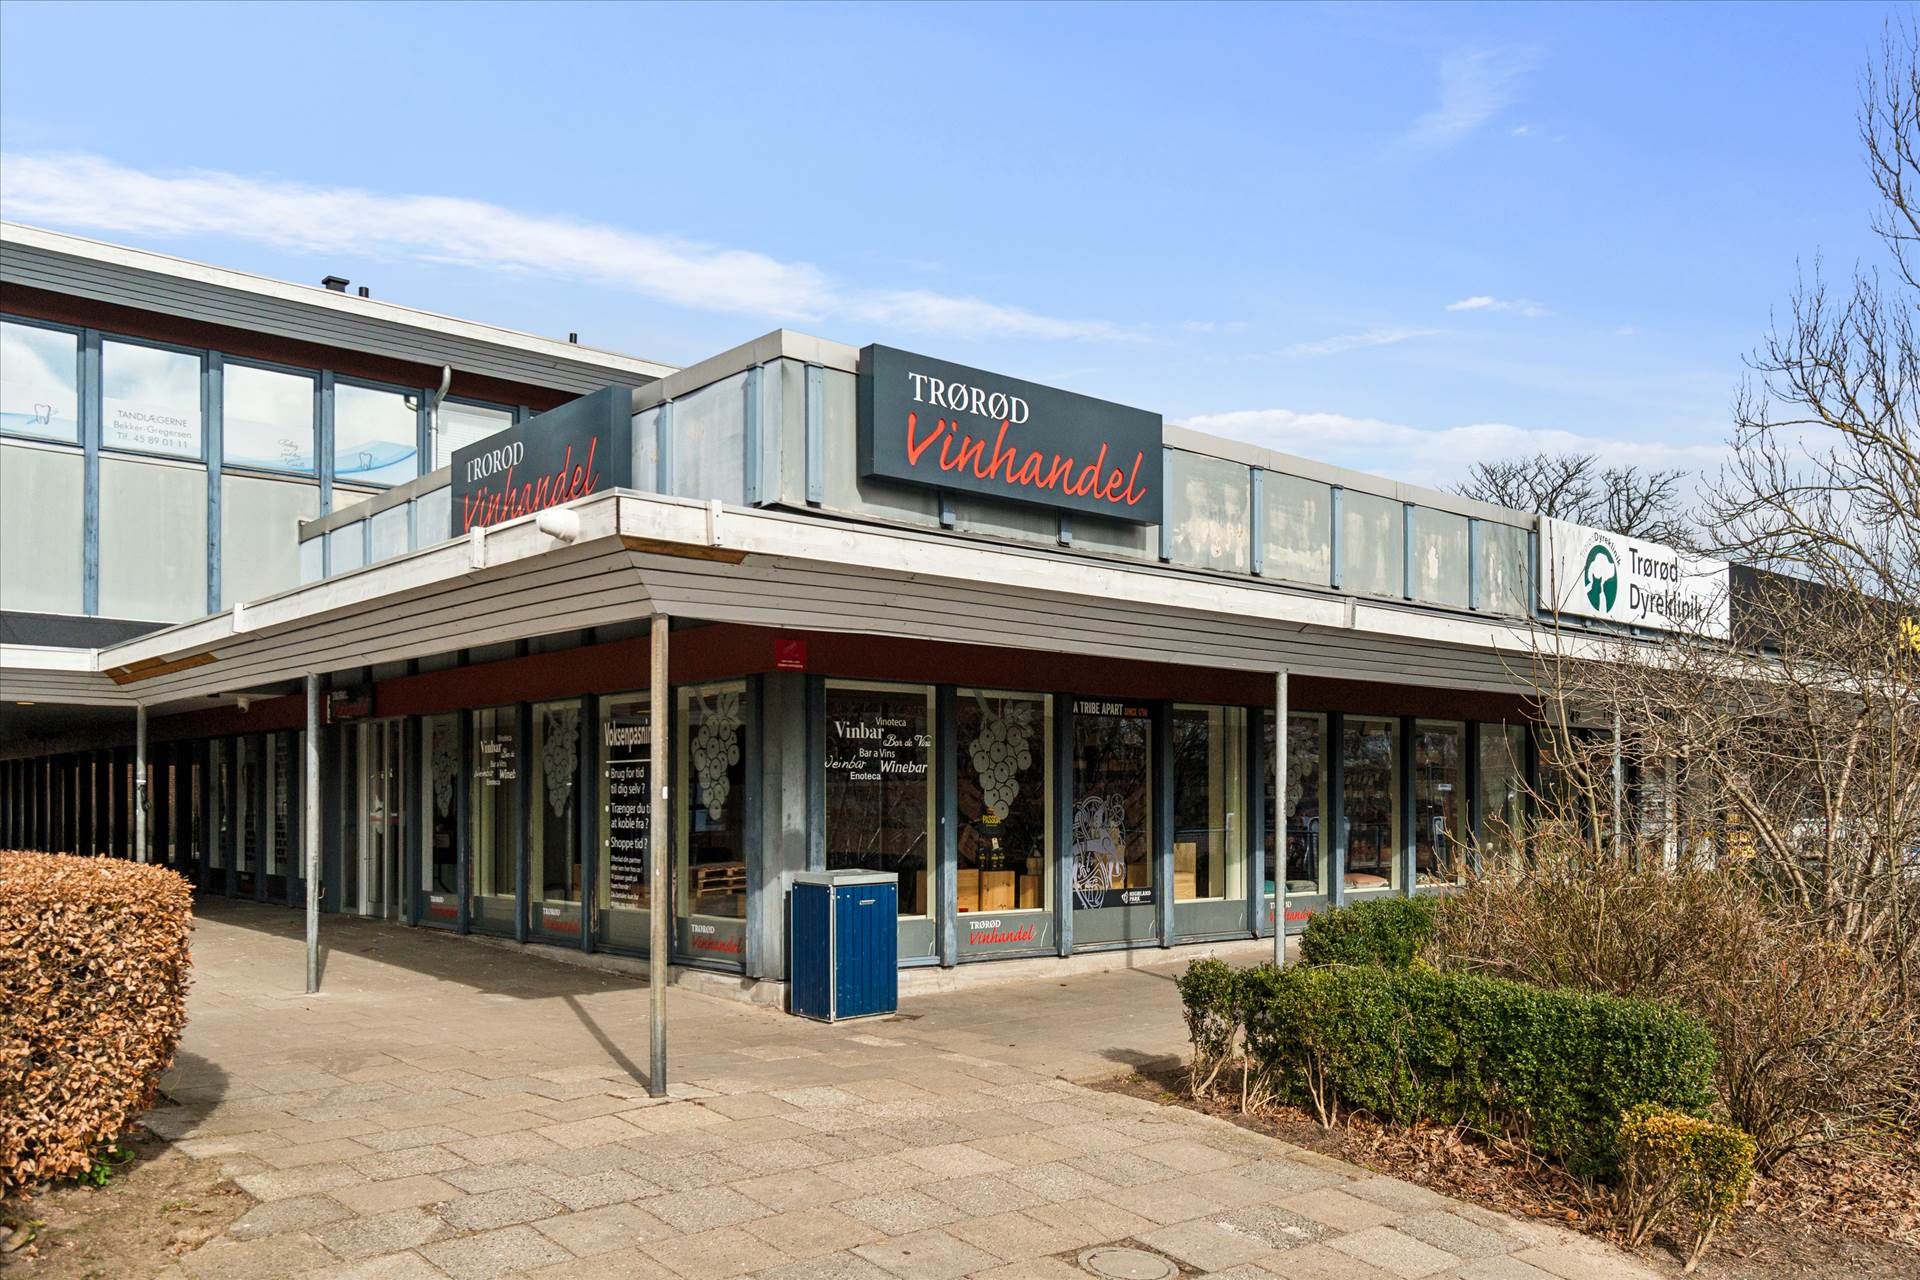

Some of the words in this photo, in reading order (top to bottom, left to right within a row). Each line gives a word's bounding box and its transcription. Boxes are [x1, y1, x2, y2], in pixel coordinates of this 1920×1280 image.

[908, 371, 1029, 424] TRØRØD
[118, 410, 188, 428] TANDLÆGERNE
[906, 410, 1148, 506] Vinhandel
[1628, 546, 1678, 583] Trørød
[1629, 583, 1703, 621] Dyreklinik
[1072, 701, 1079, 714] A
[1080, 701, 1100, 714] TRIBE
[1101, 702, 1124, 716] APART
[875, 716, 907, 728] Vinoteca
[834, 720, 885, 740] Vinbar
[859, 747, 873, 758] Bar
[873, 750, 879, 758] a
[879, 748, 896, 758] Vins
[611, 767, 625, 781] Brug
[626, 766, 635, 778] for
[635, 766, 645, 778] tid
[880, 759, 929, 774] Winebar
[849, 771, 882, 781] Enoteca
[617, 782, 628, 797] dig
[611, 802, 636, 817] Trænger
[636, 802, 646, 814] du
[611, 818, 618, 829] at
[618, 817, 635, 829] koble
[610, 836, 634, 851] Shoppe
[969, 919, 1001, 930] TRØRØD
[969, 922, 1037, 945] Vinhandel
